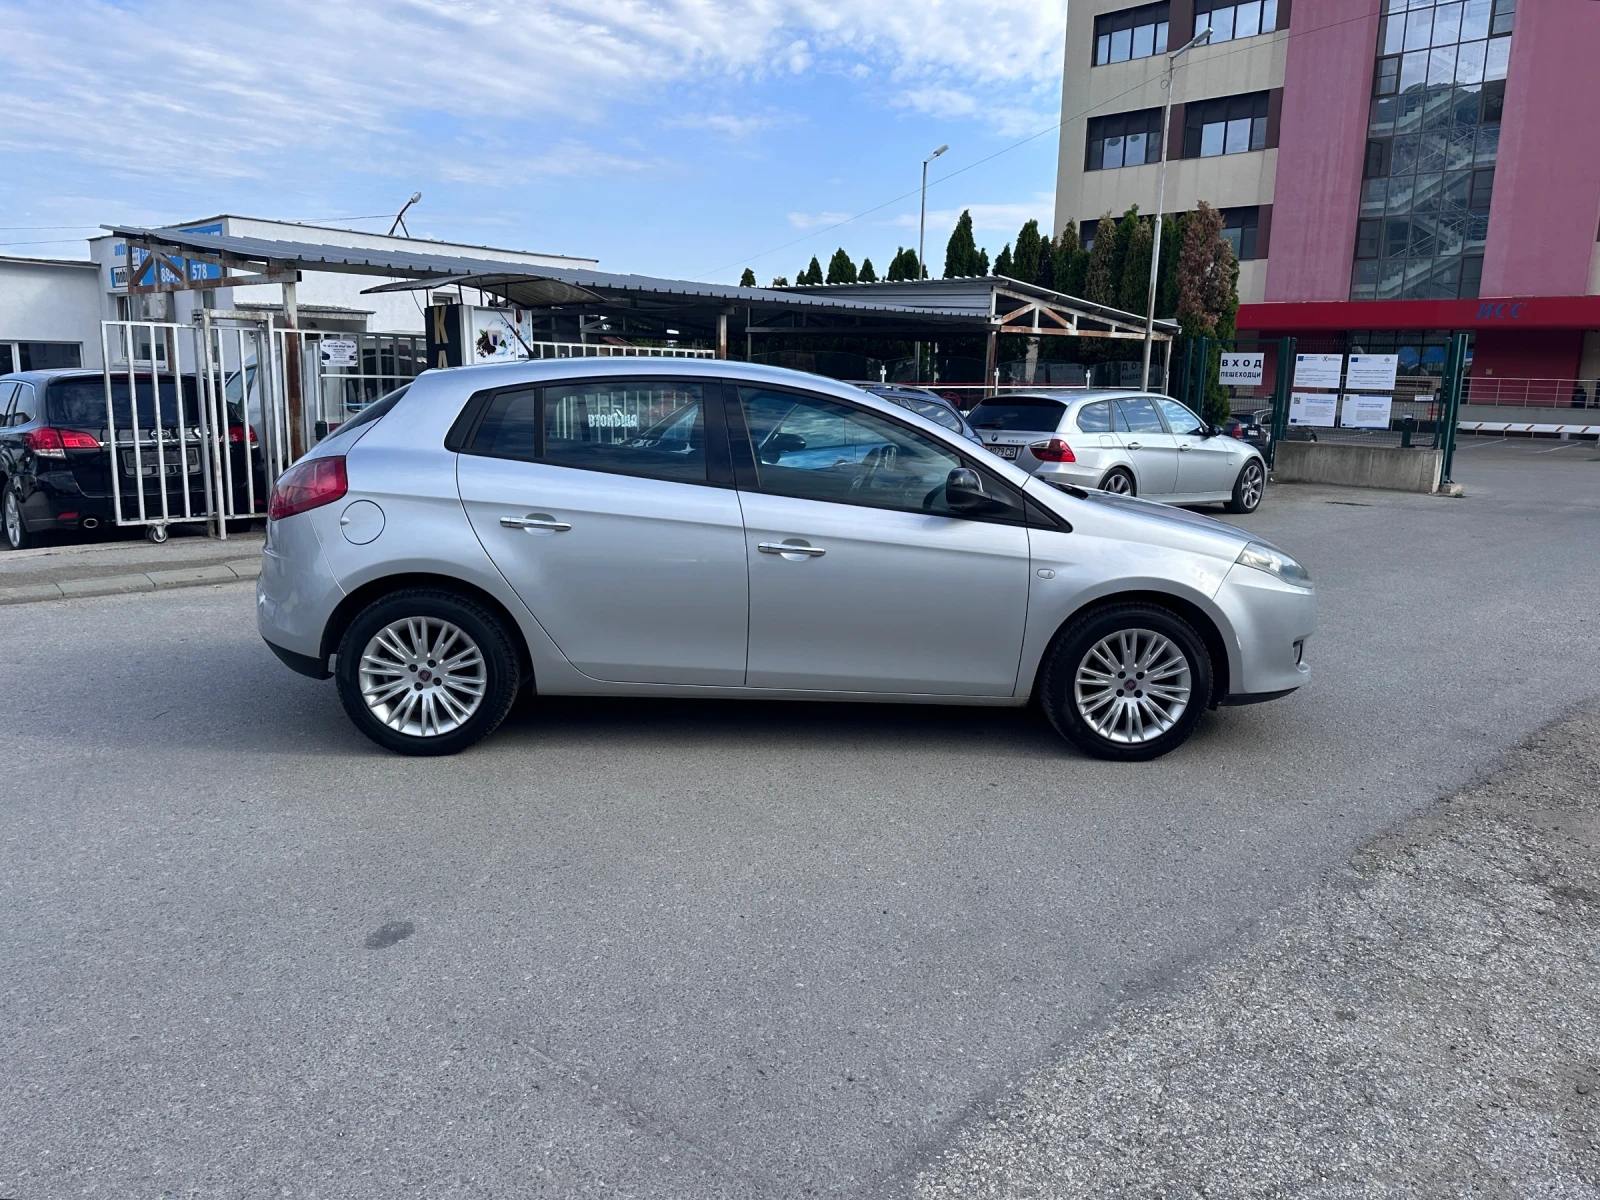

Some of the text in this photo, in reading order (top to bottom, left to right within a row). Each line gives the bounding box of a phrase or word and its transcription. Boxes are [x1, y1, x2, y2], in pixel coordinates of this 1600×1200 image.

[192, 264, 207, 280] 578
[1476, 302, 1527, 319] ИСС
[1222, 359, 1262, 369] ВХОД
[1220, 371, 1261, 379] ПЕШЕХОДЦИ
